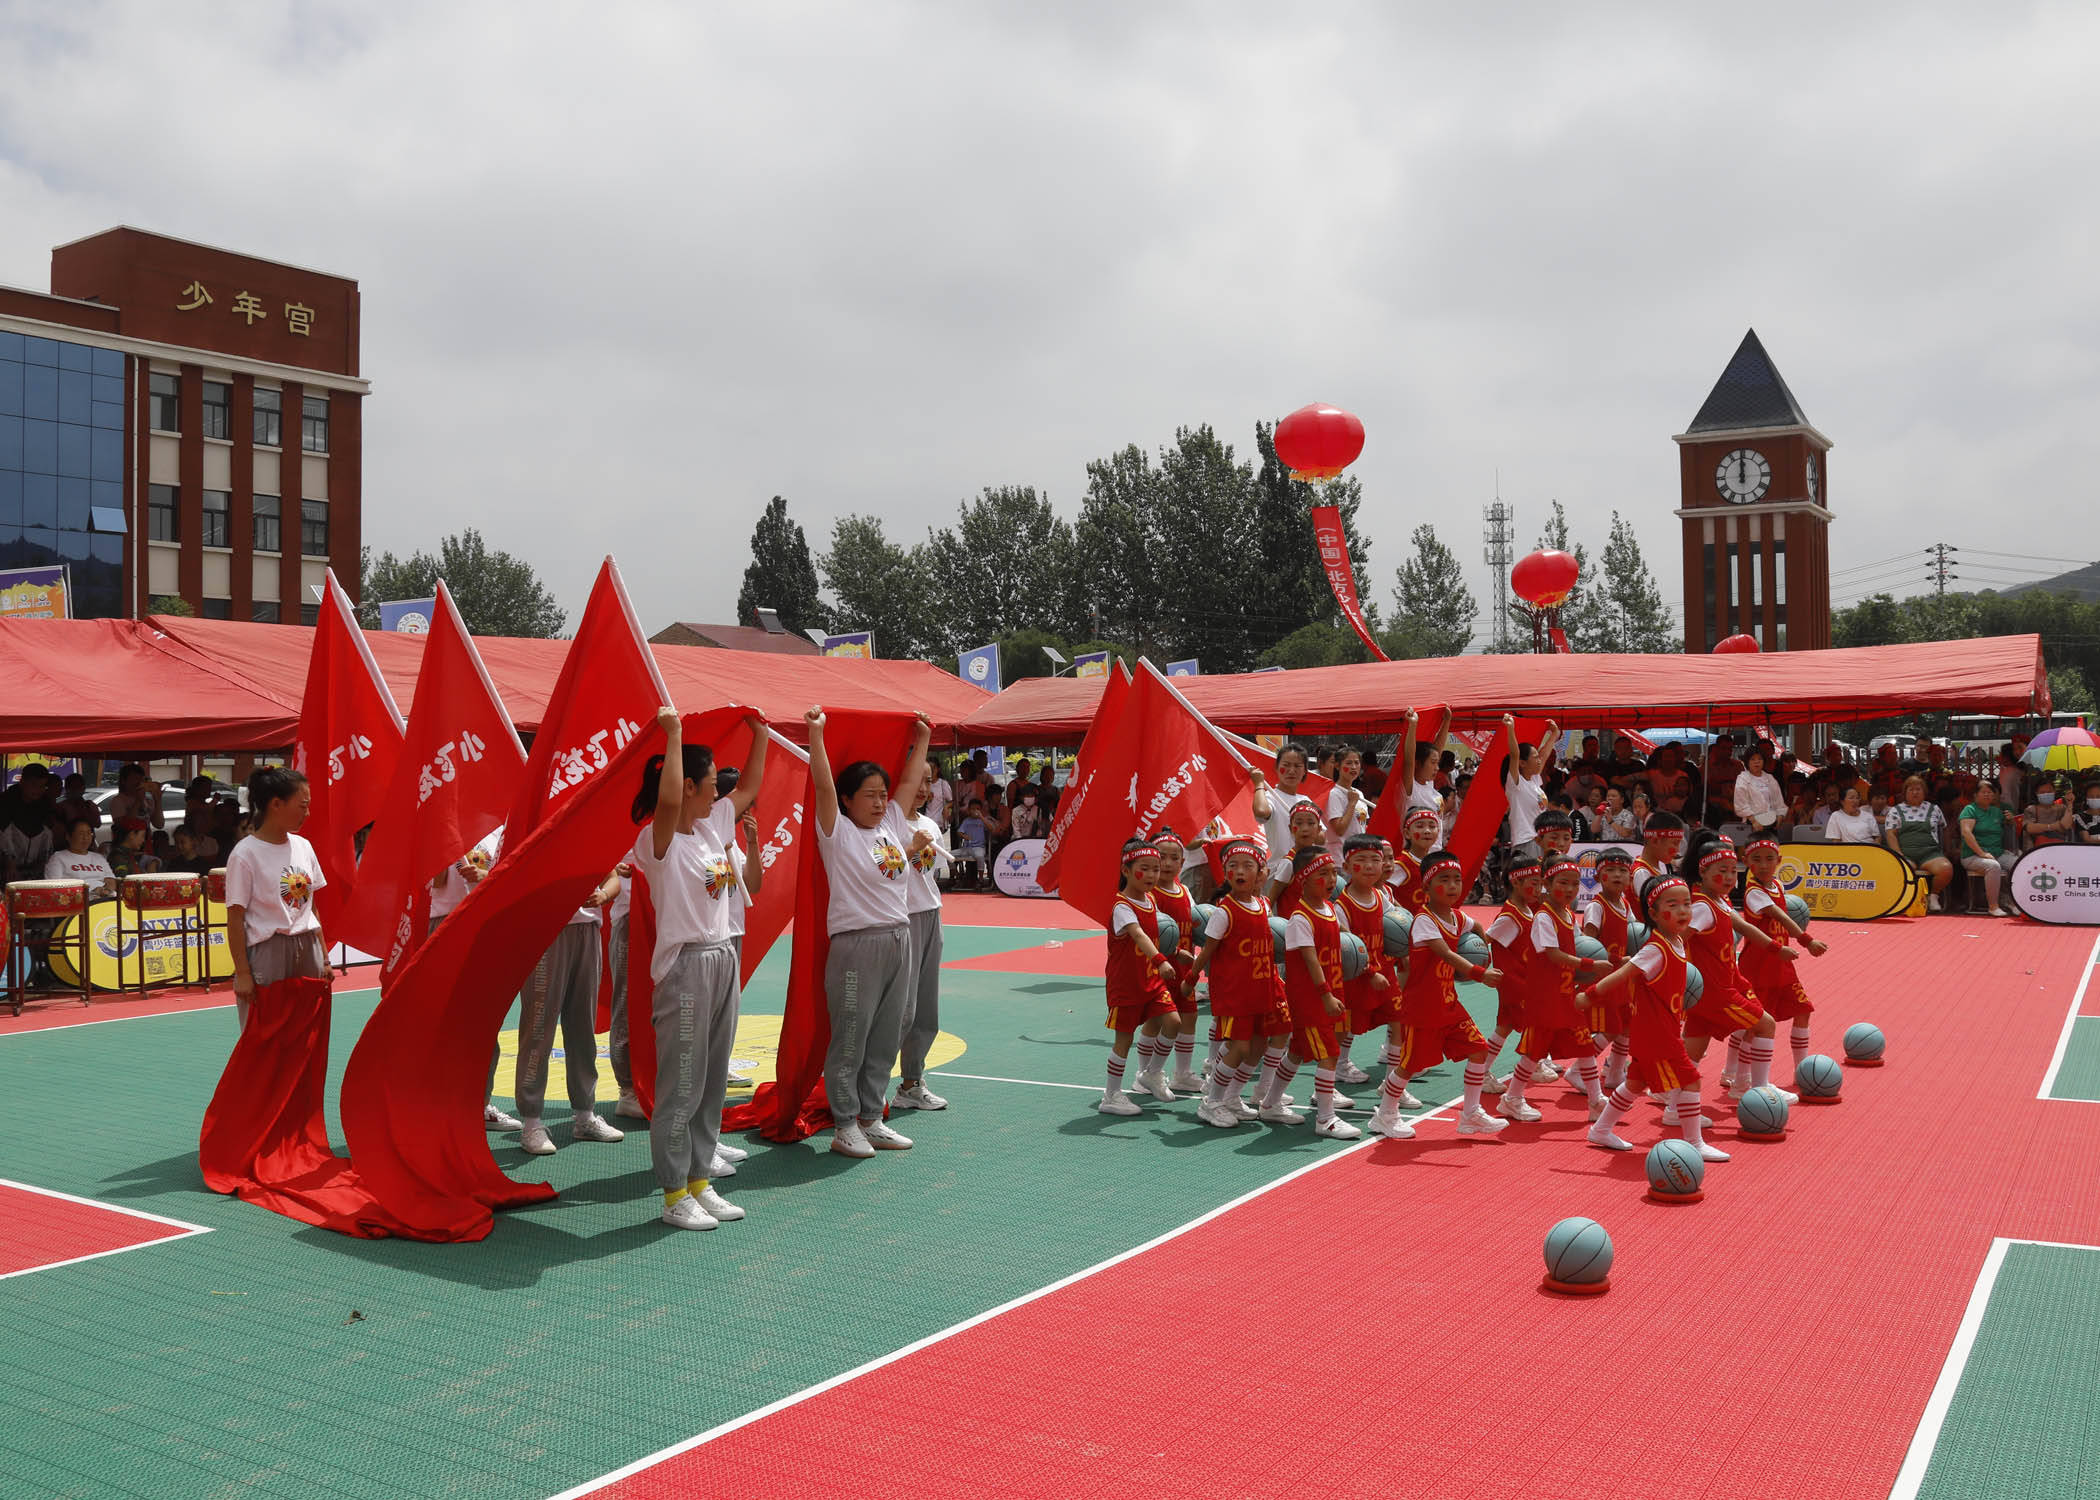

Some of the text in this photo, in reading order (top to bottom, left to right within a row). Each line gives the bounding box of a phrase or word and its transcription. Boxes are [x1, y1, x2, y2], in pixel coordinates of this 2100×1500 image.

[176, 281, 315, 337] 少年宫
[1232, 847, 1254, 855] CHINA
[1701, 852, 1722, 866] CHINA
[1303, 858, 1324, 876] CHINA
[1547, 863, 1569, 876] CHINA
[1807, 862, 1862, 877] NYBO
[1652, 879, 1676, 897] CHINA
[1805, 879, 1876, 891] 青少年篮球公开赛
[2064, 876, 2100, 889] 中国中
[2029, 894, 2058, 902] CSSF
[2064, 890, 2086, 898] China
[1252, 955, 1272, 980] 23
